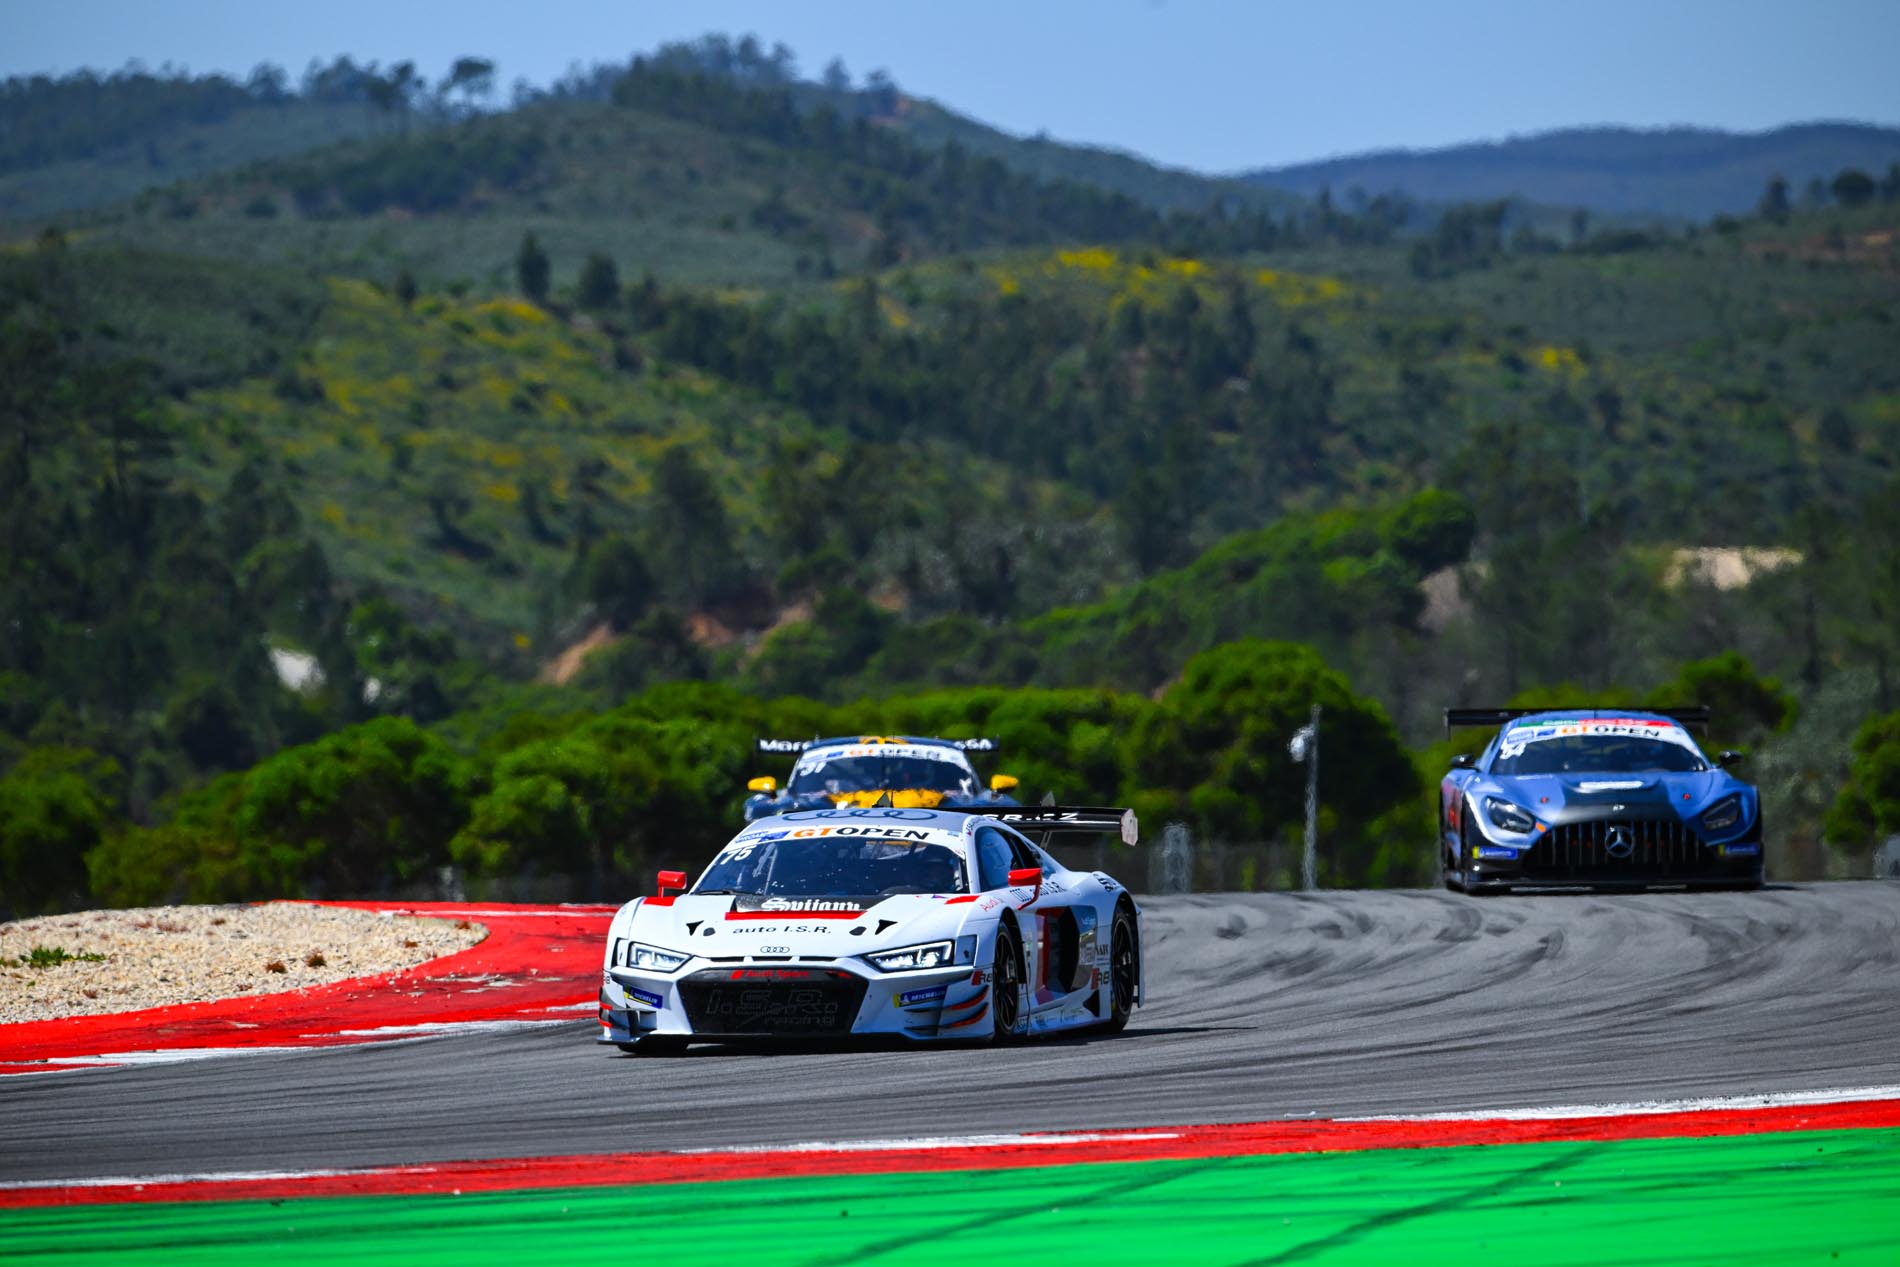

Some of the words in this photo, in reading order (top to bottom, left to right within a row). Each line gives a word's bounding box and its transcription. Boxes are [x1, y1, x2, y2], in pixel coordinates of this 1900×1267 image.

[720, 844, 757, 865] 75
[733, 926, 777, 934] auto
[784, 925, 832, 934] I.S.R.
[745, 969, 773, 978] Audi
[777, 969, 809, 980] Sport
